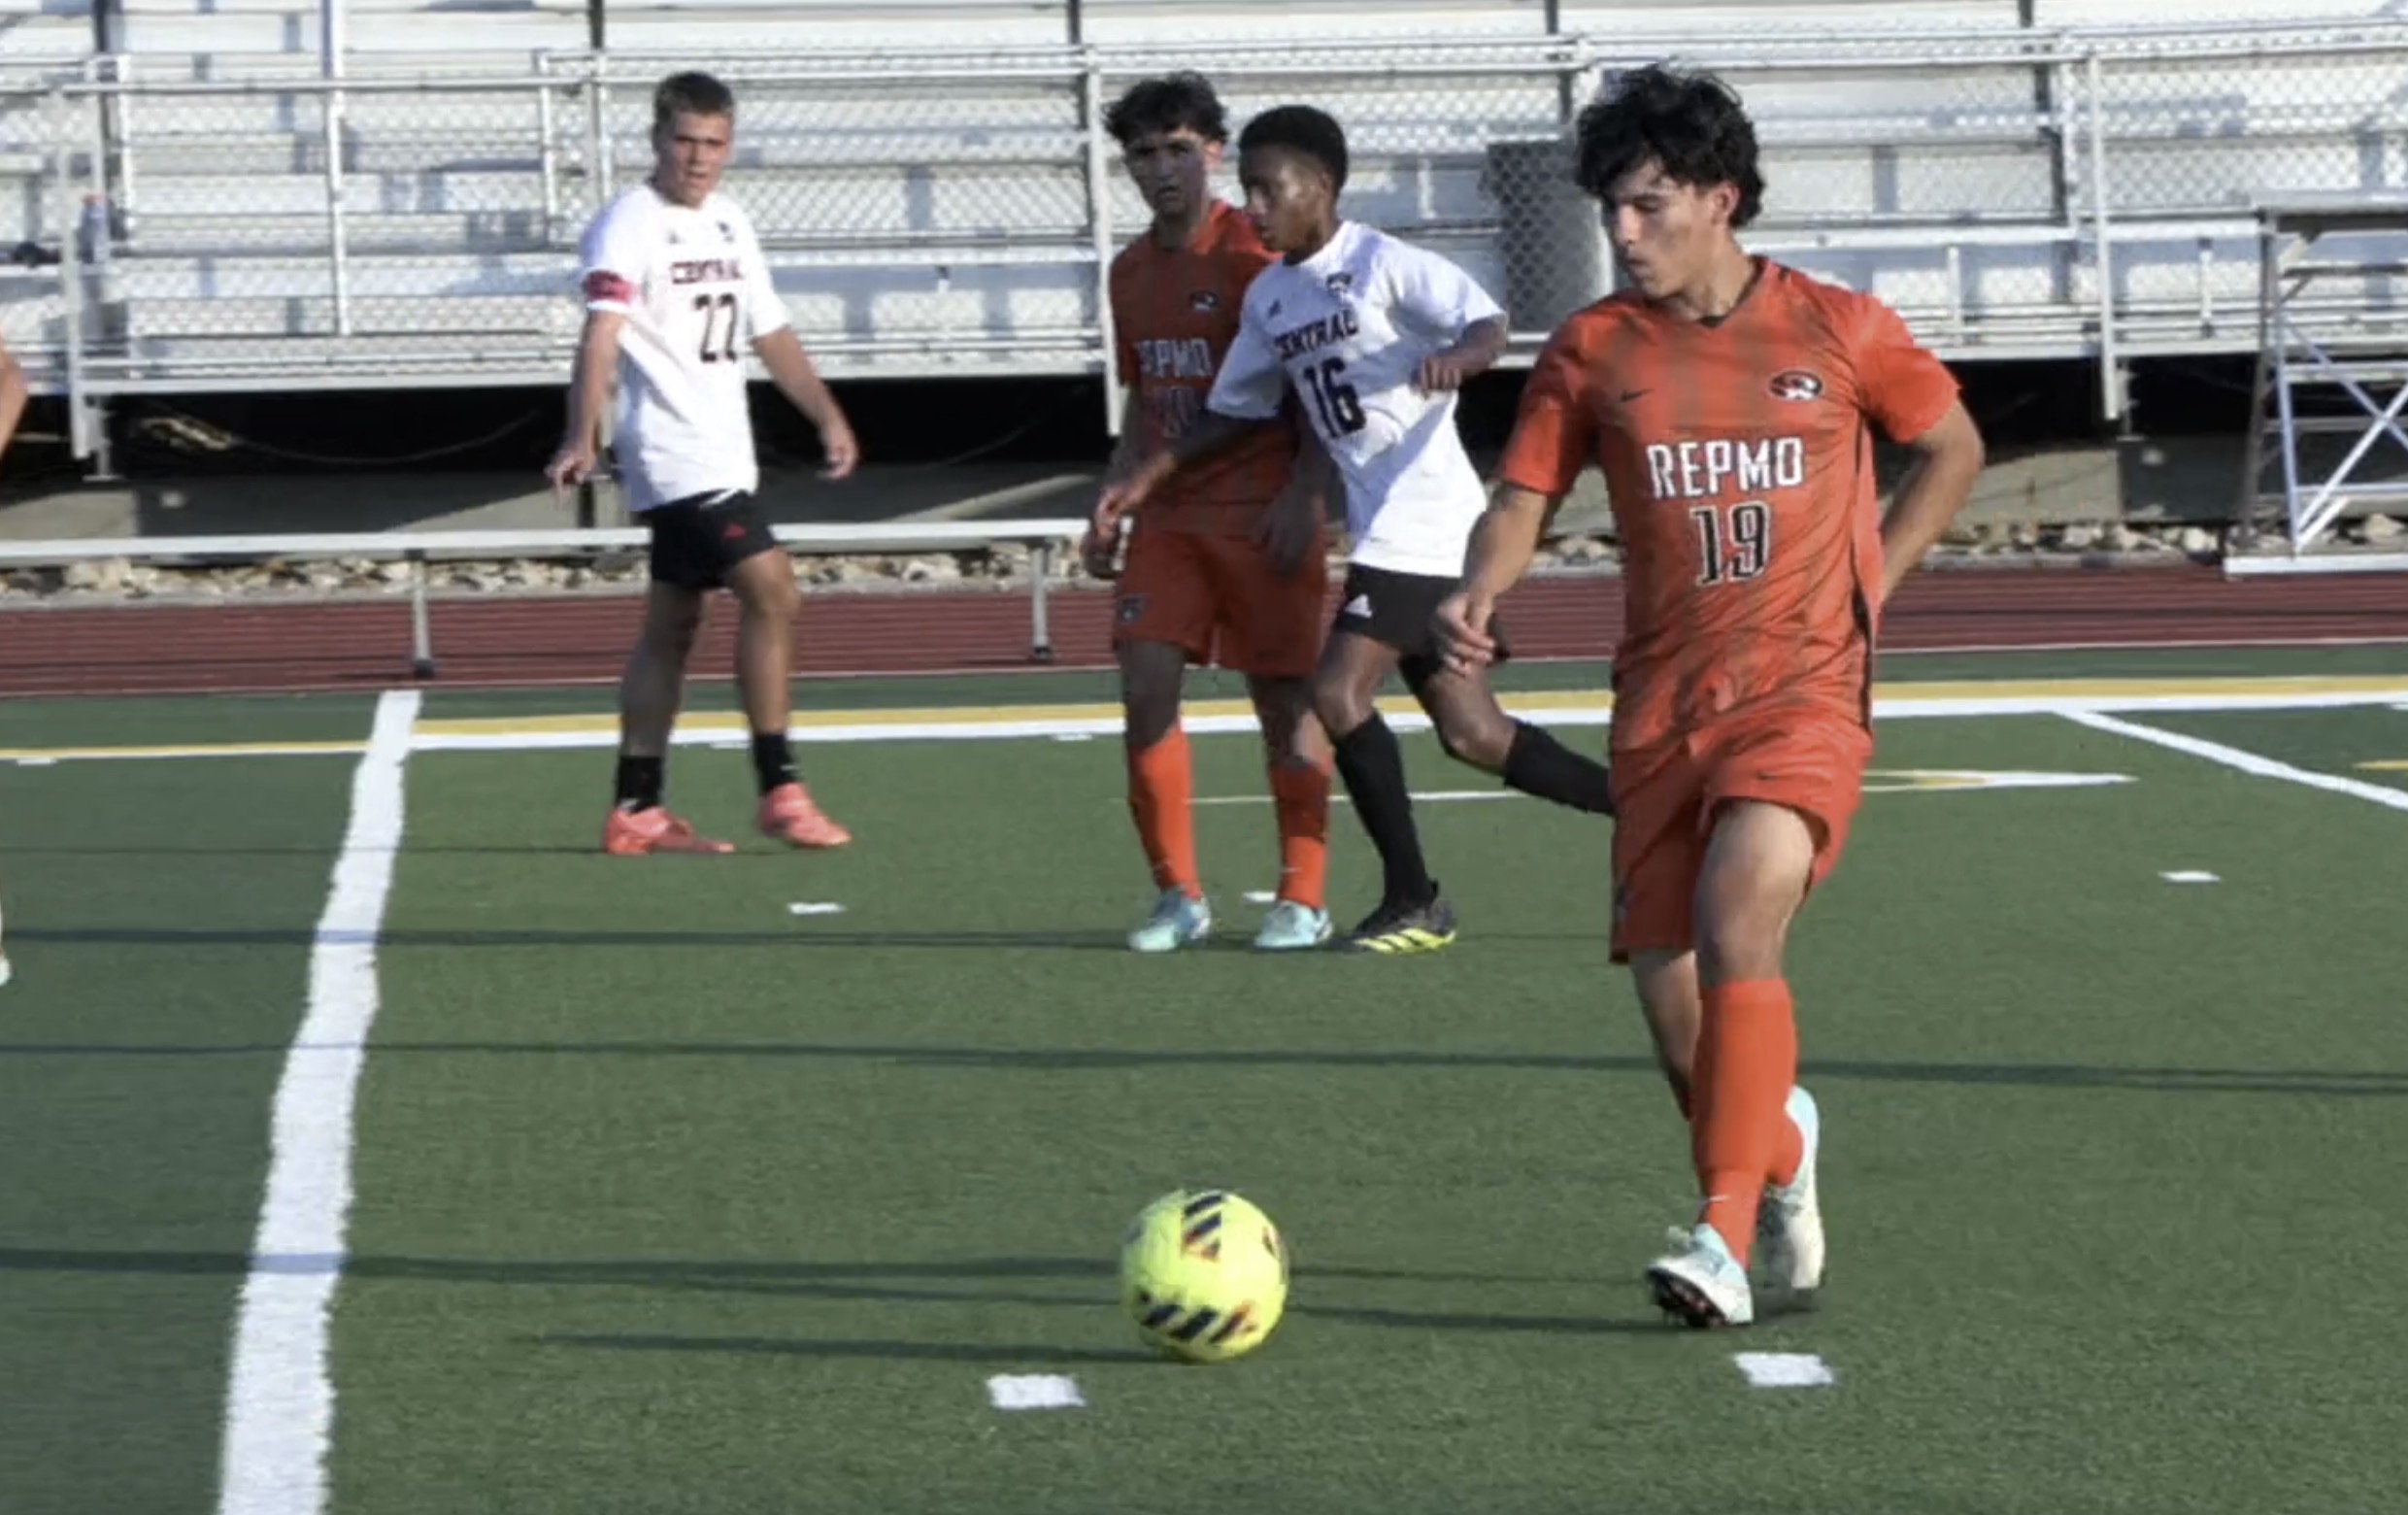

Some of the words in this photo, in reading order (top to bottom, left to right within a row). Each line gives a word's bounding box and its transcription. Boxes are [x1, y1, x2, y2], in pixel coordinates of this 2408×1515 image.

[694, 292, 738, 363] 22
[1303, 355, 1367, 439] 16
[1646, 437, 1805, 499] REPMO
[1689, 499, 1770, 587] 19
